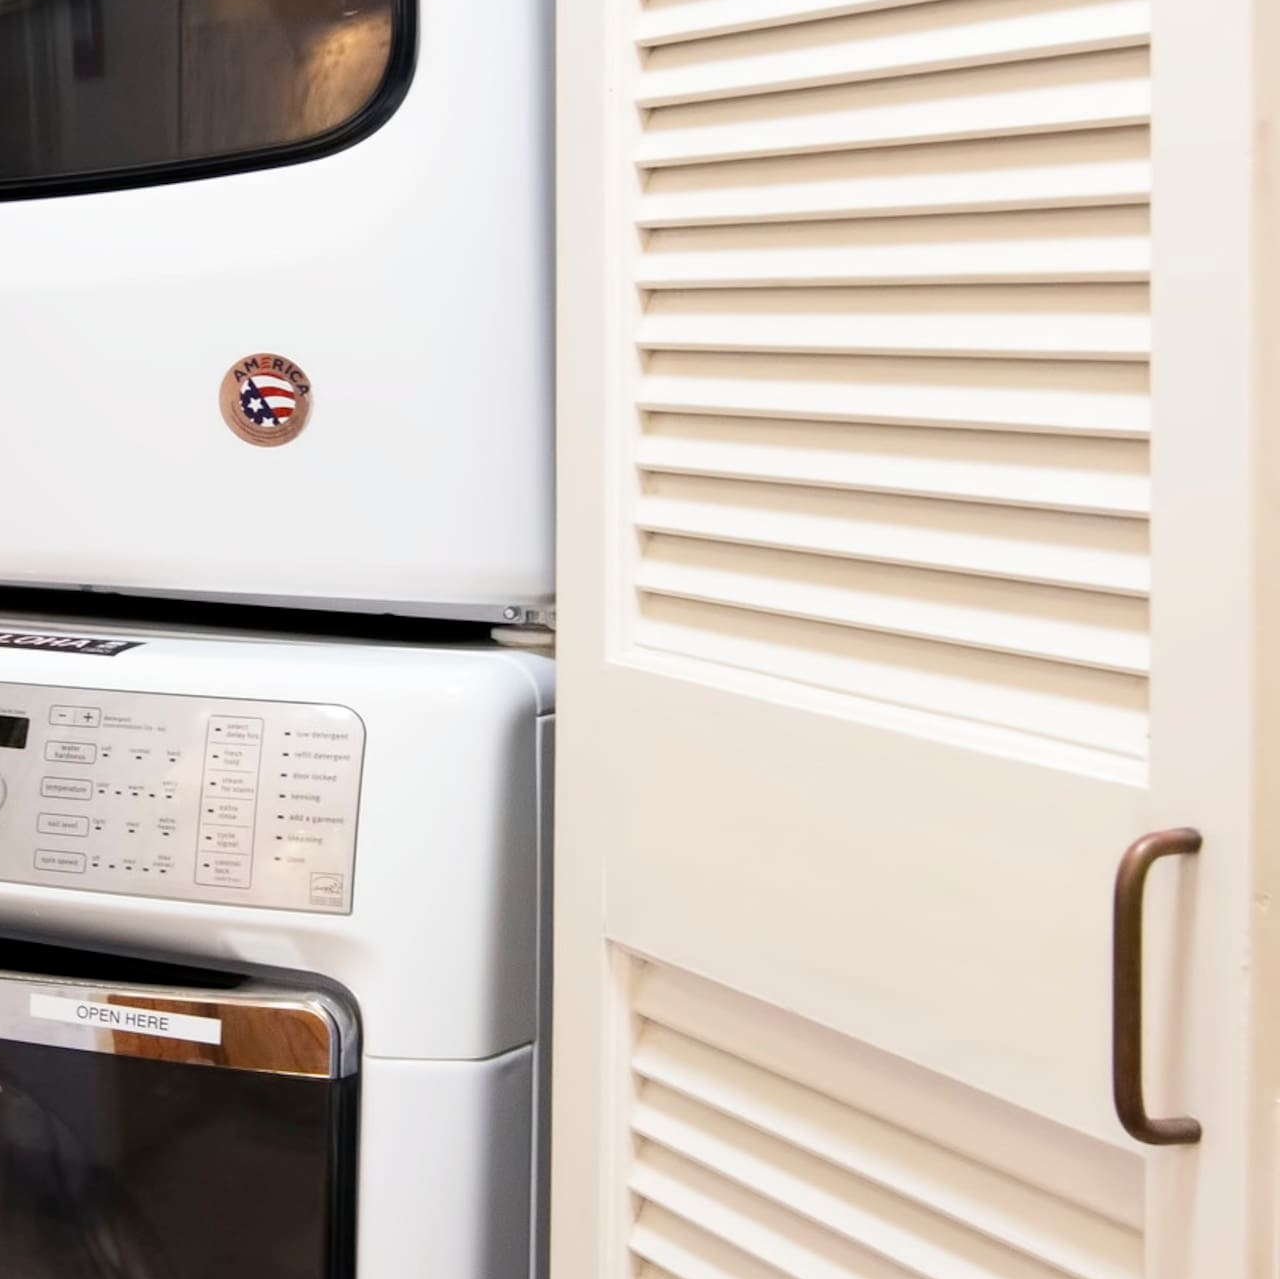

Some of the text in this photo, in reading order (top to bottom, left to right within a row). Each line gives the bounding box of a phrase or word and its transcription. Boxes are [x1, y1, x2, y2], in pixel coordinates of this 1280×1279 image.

[233, 356, 309, 397] AMERICA
[76, 1004, 169, 1031] OPEN HERE
